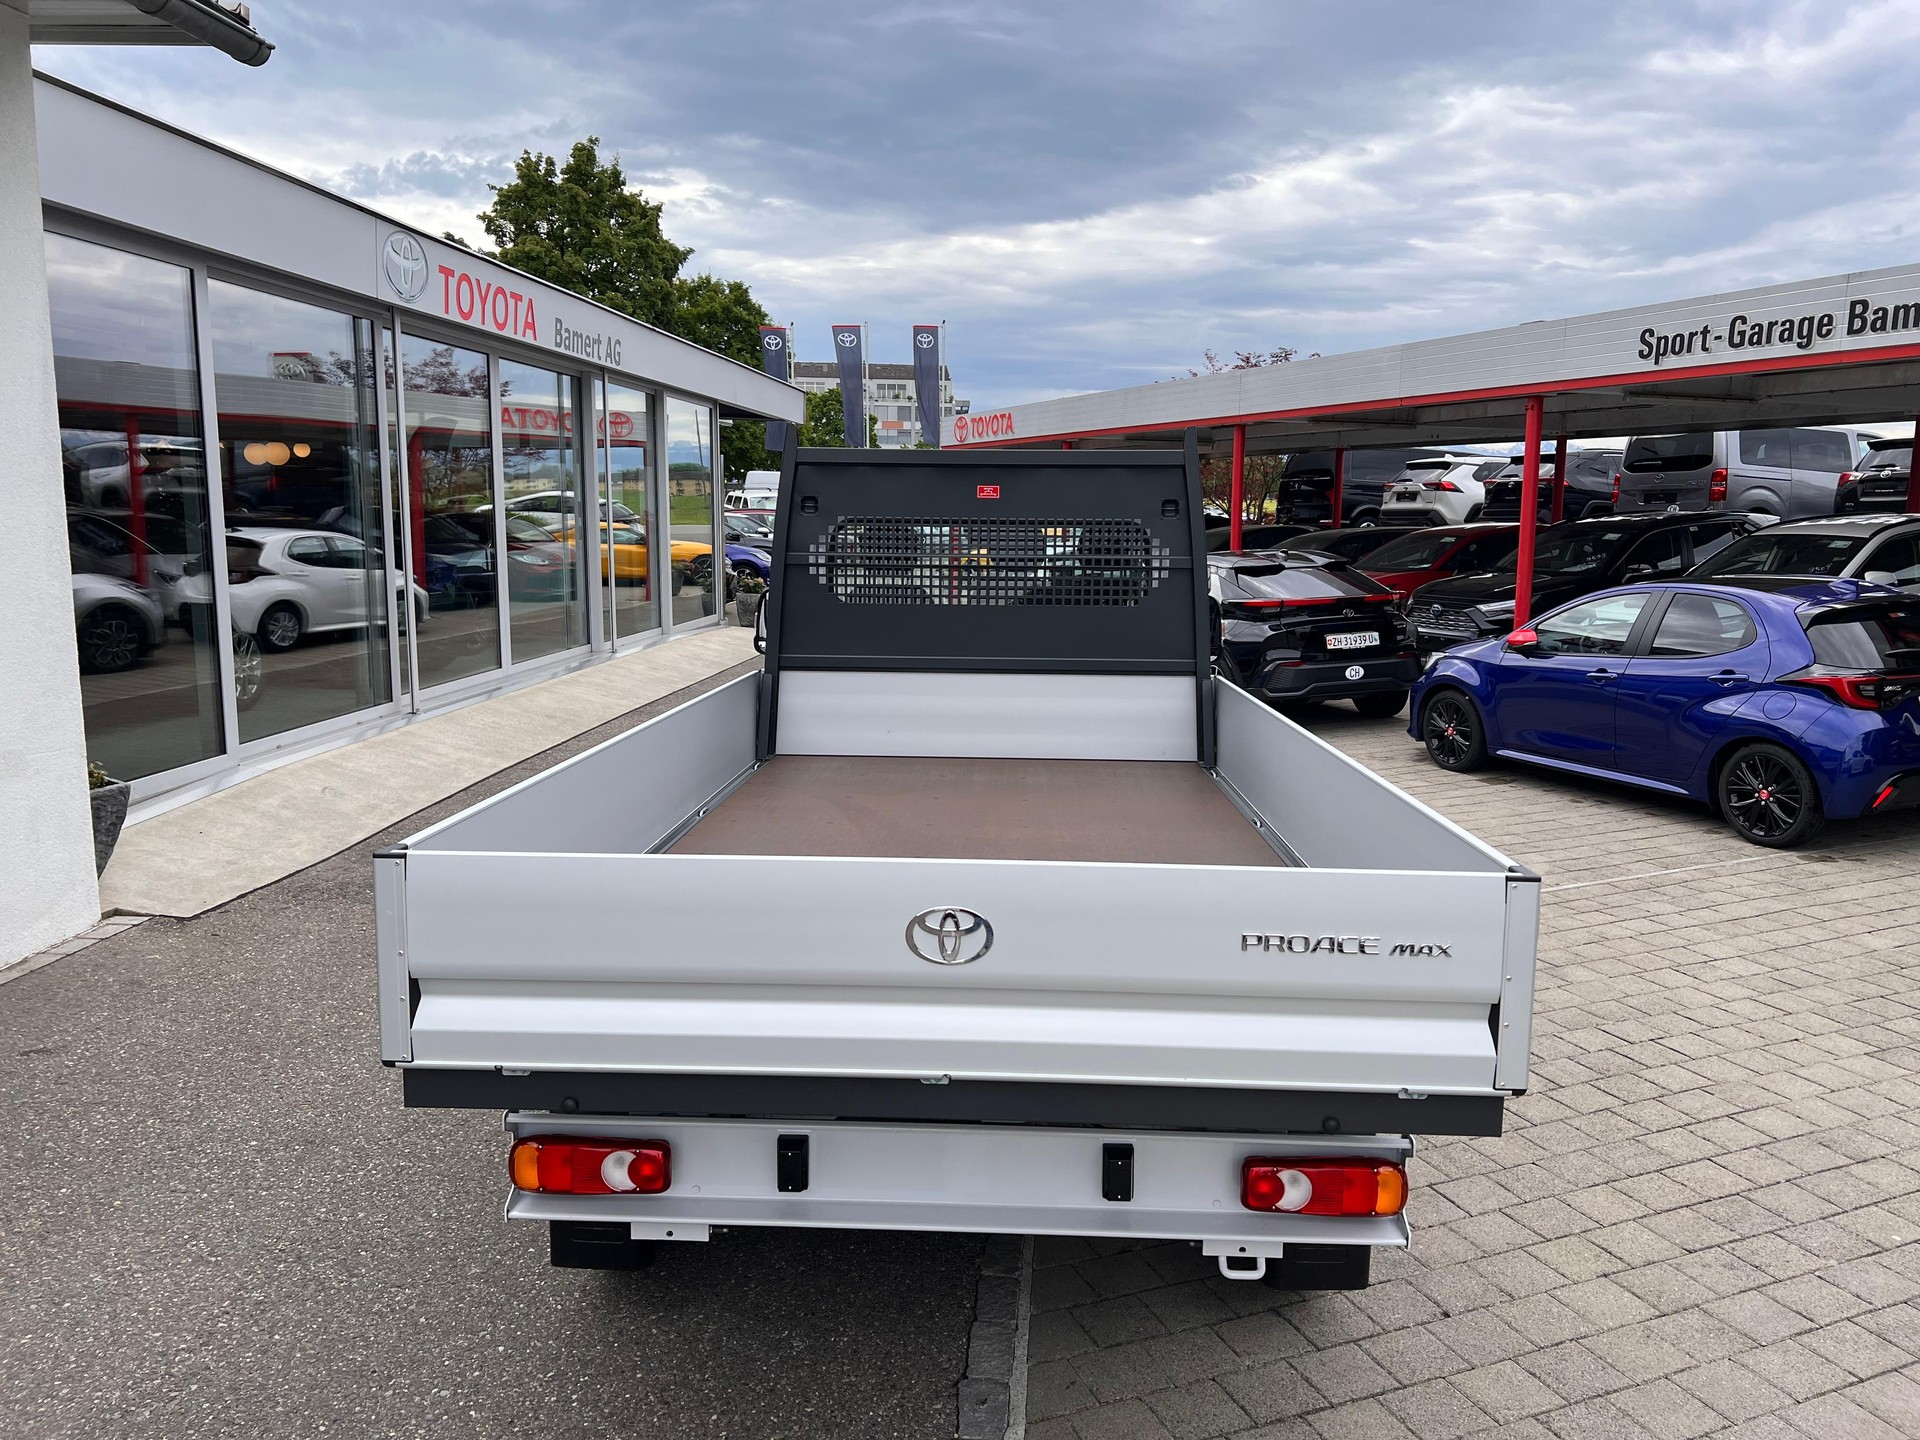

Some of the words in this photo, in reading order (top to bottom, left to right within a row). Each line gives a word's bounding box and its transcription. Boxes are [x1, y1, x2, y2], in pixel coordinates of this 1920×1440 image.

[438, 264, 537, 342] TOYOTA
[554, 317, 602, 361] Bamert
[605, 336, 621, 366] AG
[1638, 313, 1834, 366] Sport-Garage
[1847, 299, 1920, 336] Bam
[971, 413, 1014, 438] TOYOTA
[1332, 637, 1343, 647] ZH
[1344, 634, 1367, 646] 31939
[1368, 634, 1374, 644] U
[1349, 667, 1360, 678] CH
[1241, 932, 1381, 955] PROACE
[1388, 942, 1452, 958] MAX
